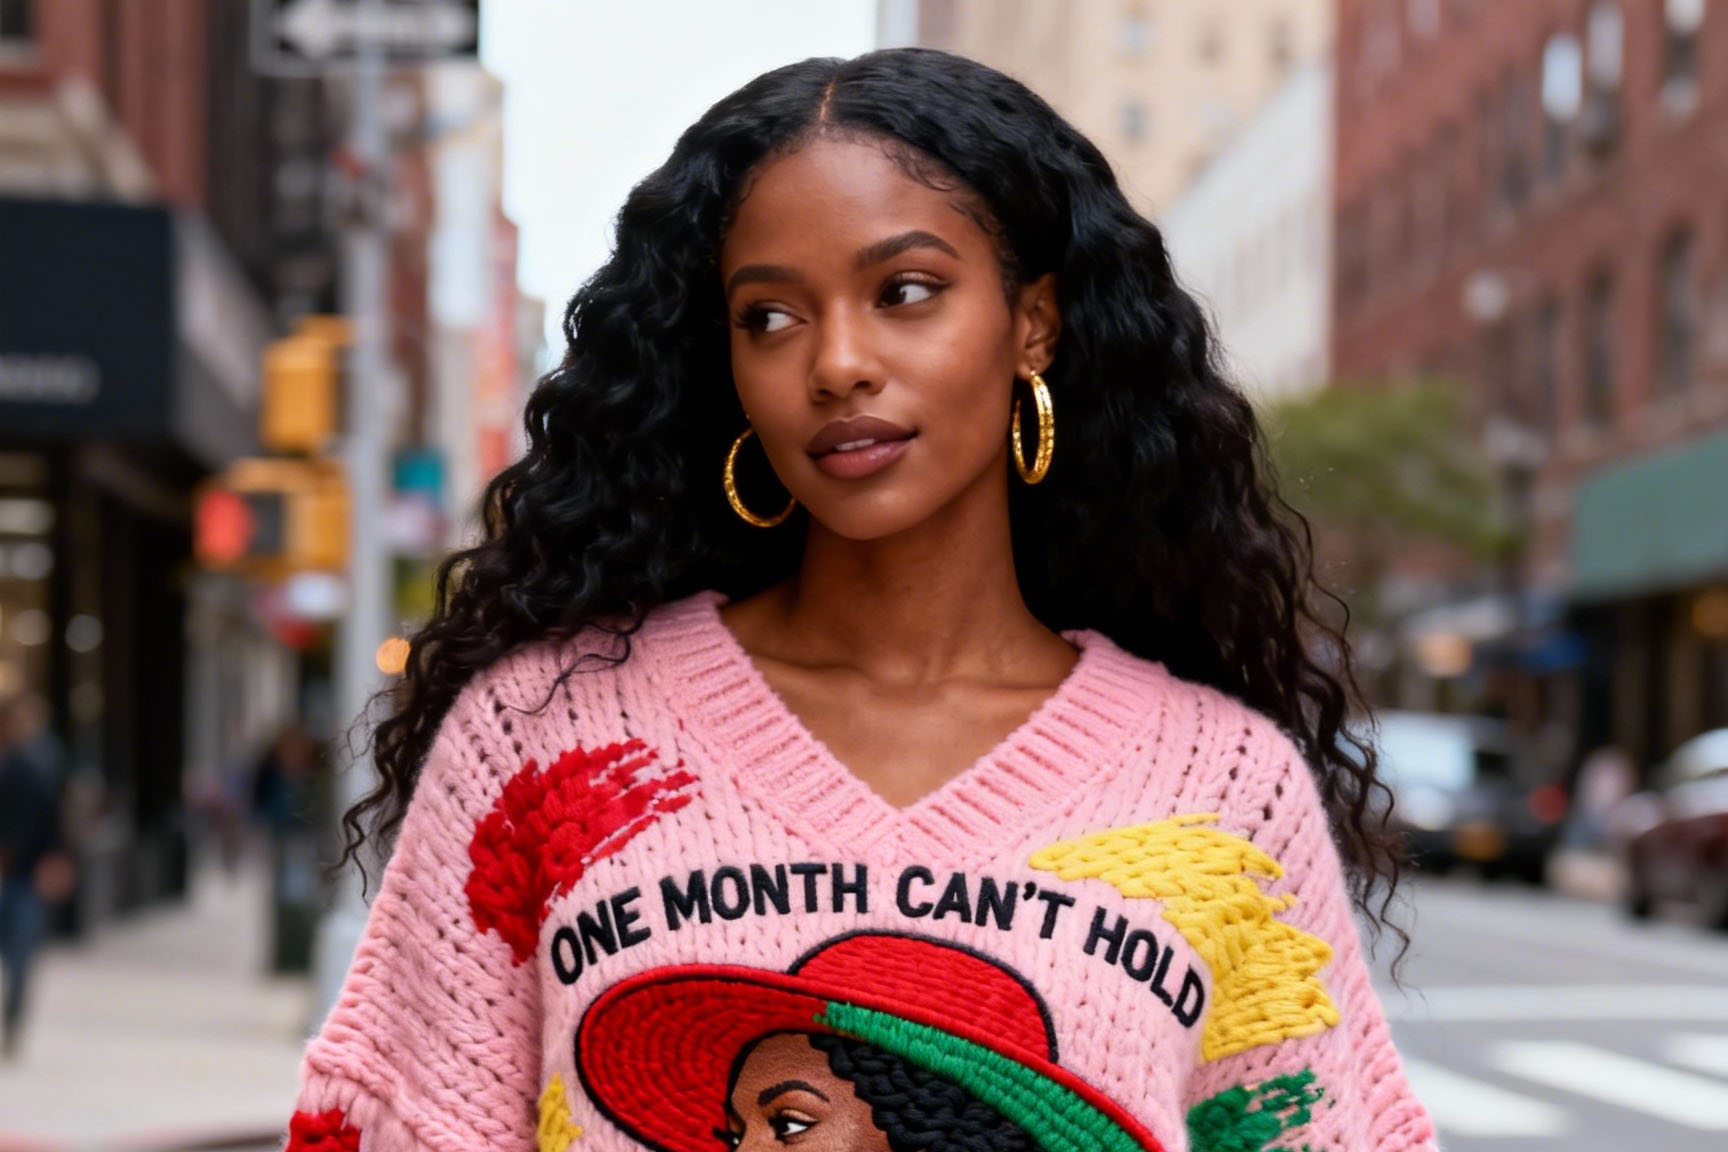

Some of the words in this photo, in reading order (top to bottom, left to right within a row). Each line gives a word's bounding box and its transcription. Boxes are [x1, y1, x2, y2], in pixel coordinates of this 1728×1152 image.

[551, 887, 651, 985] ONE
[659, 863, 868, 931] MONTH
[895, 866, 1075, 939] CAN'T
[1083, 906, 1206, 1027] HOLD
